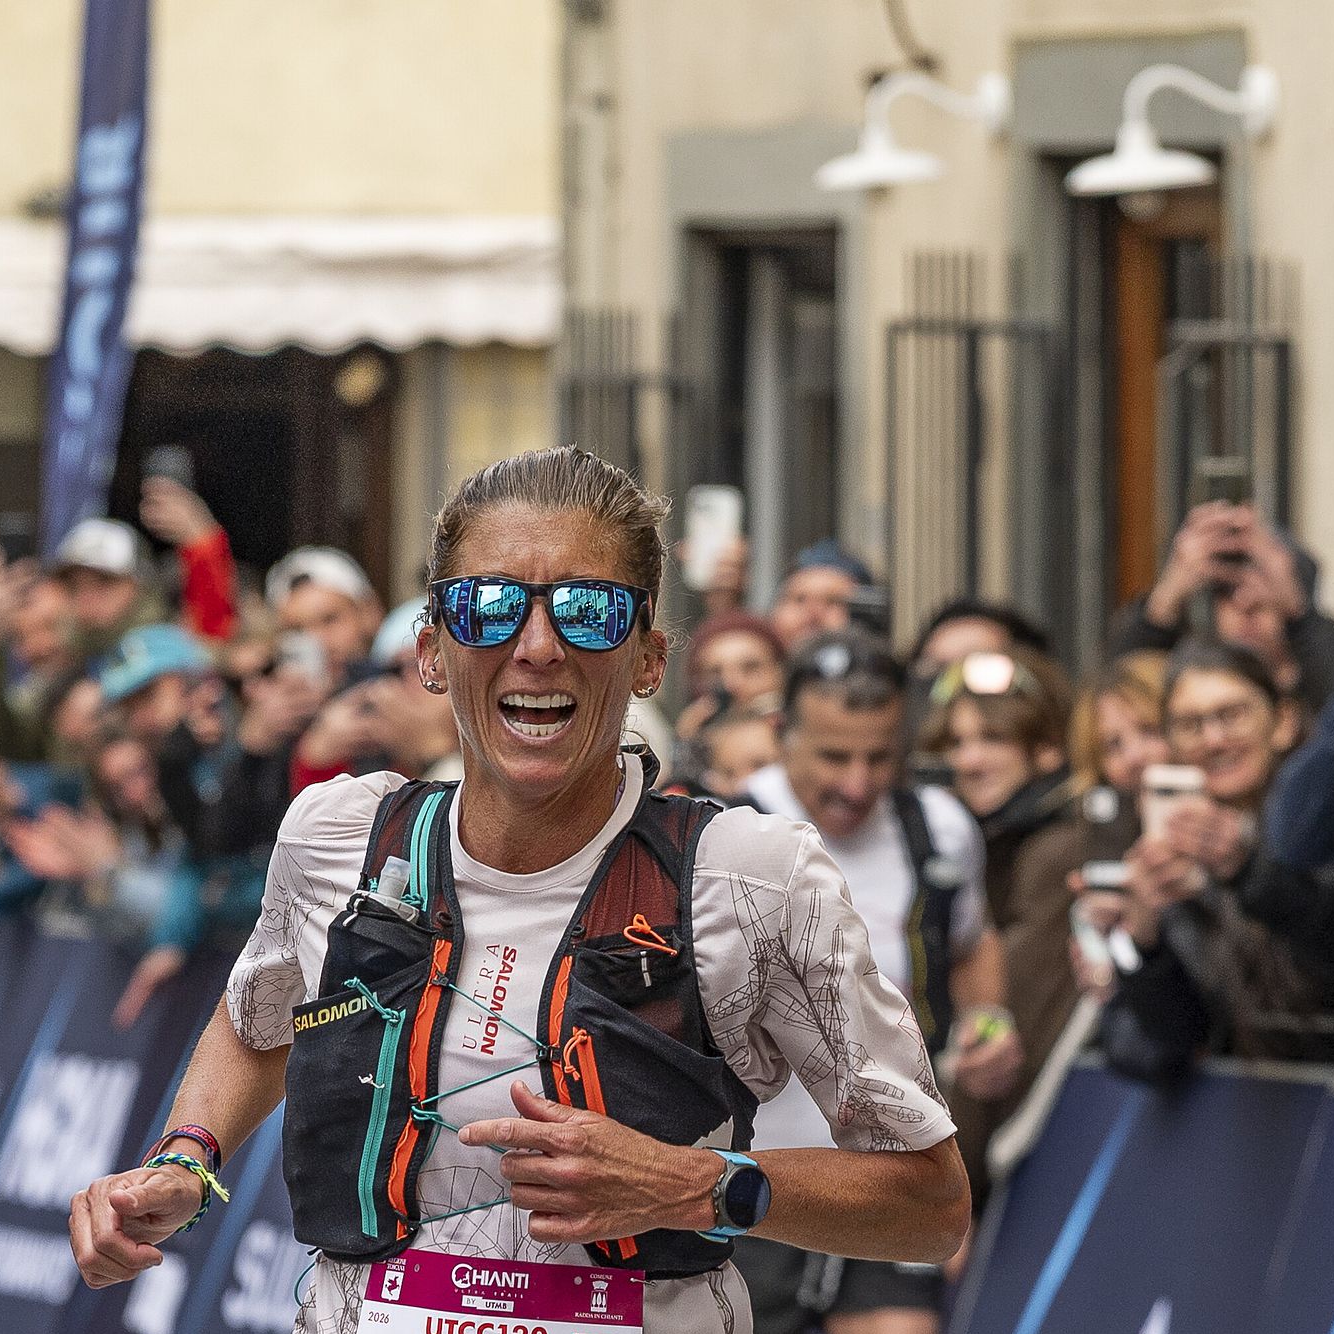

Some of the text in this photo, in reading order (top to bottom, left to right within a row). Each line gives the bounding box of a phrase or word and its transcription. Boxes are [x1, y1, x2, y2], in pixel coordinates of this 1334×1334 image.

[294, 992, 378, 1033] SALOMON
[480, 945, 517, 1056] SALOMON
[452, 1263, 529, 1289] CHIANTI
[368, 1311, 390, 1324] 2026
[485, 1301, 507, 1309] UTMB
